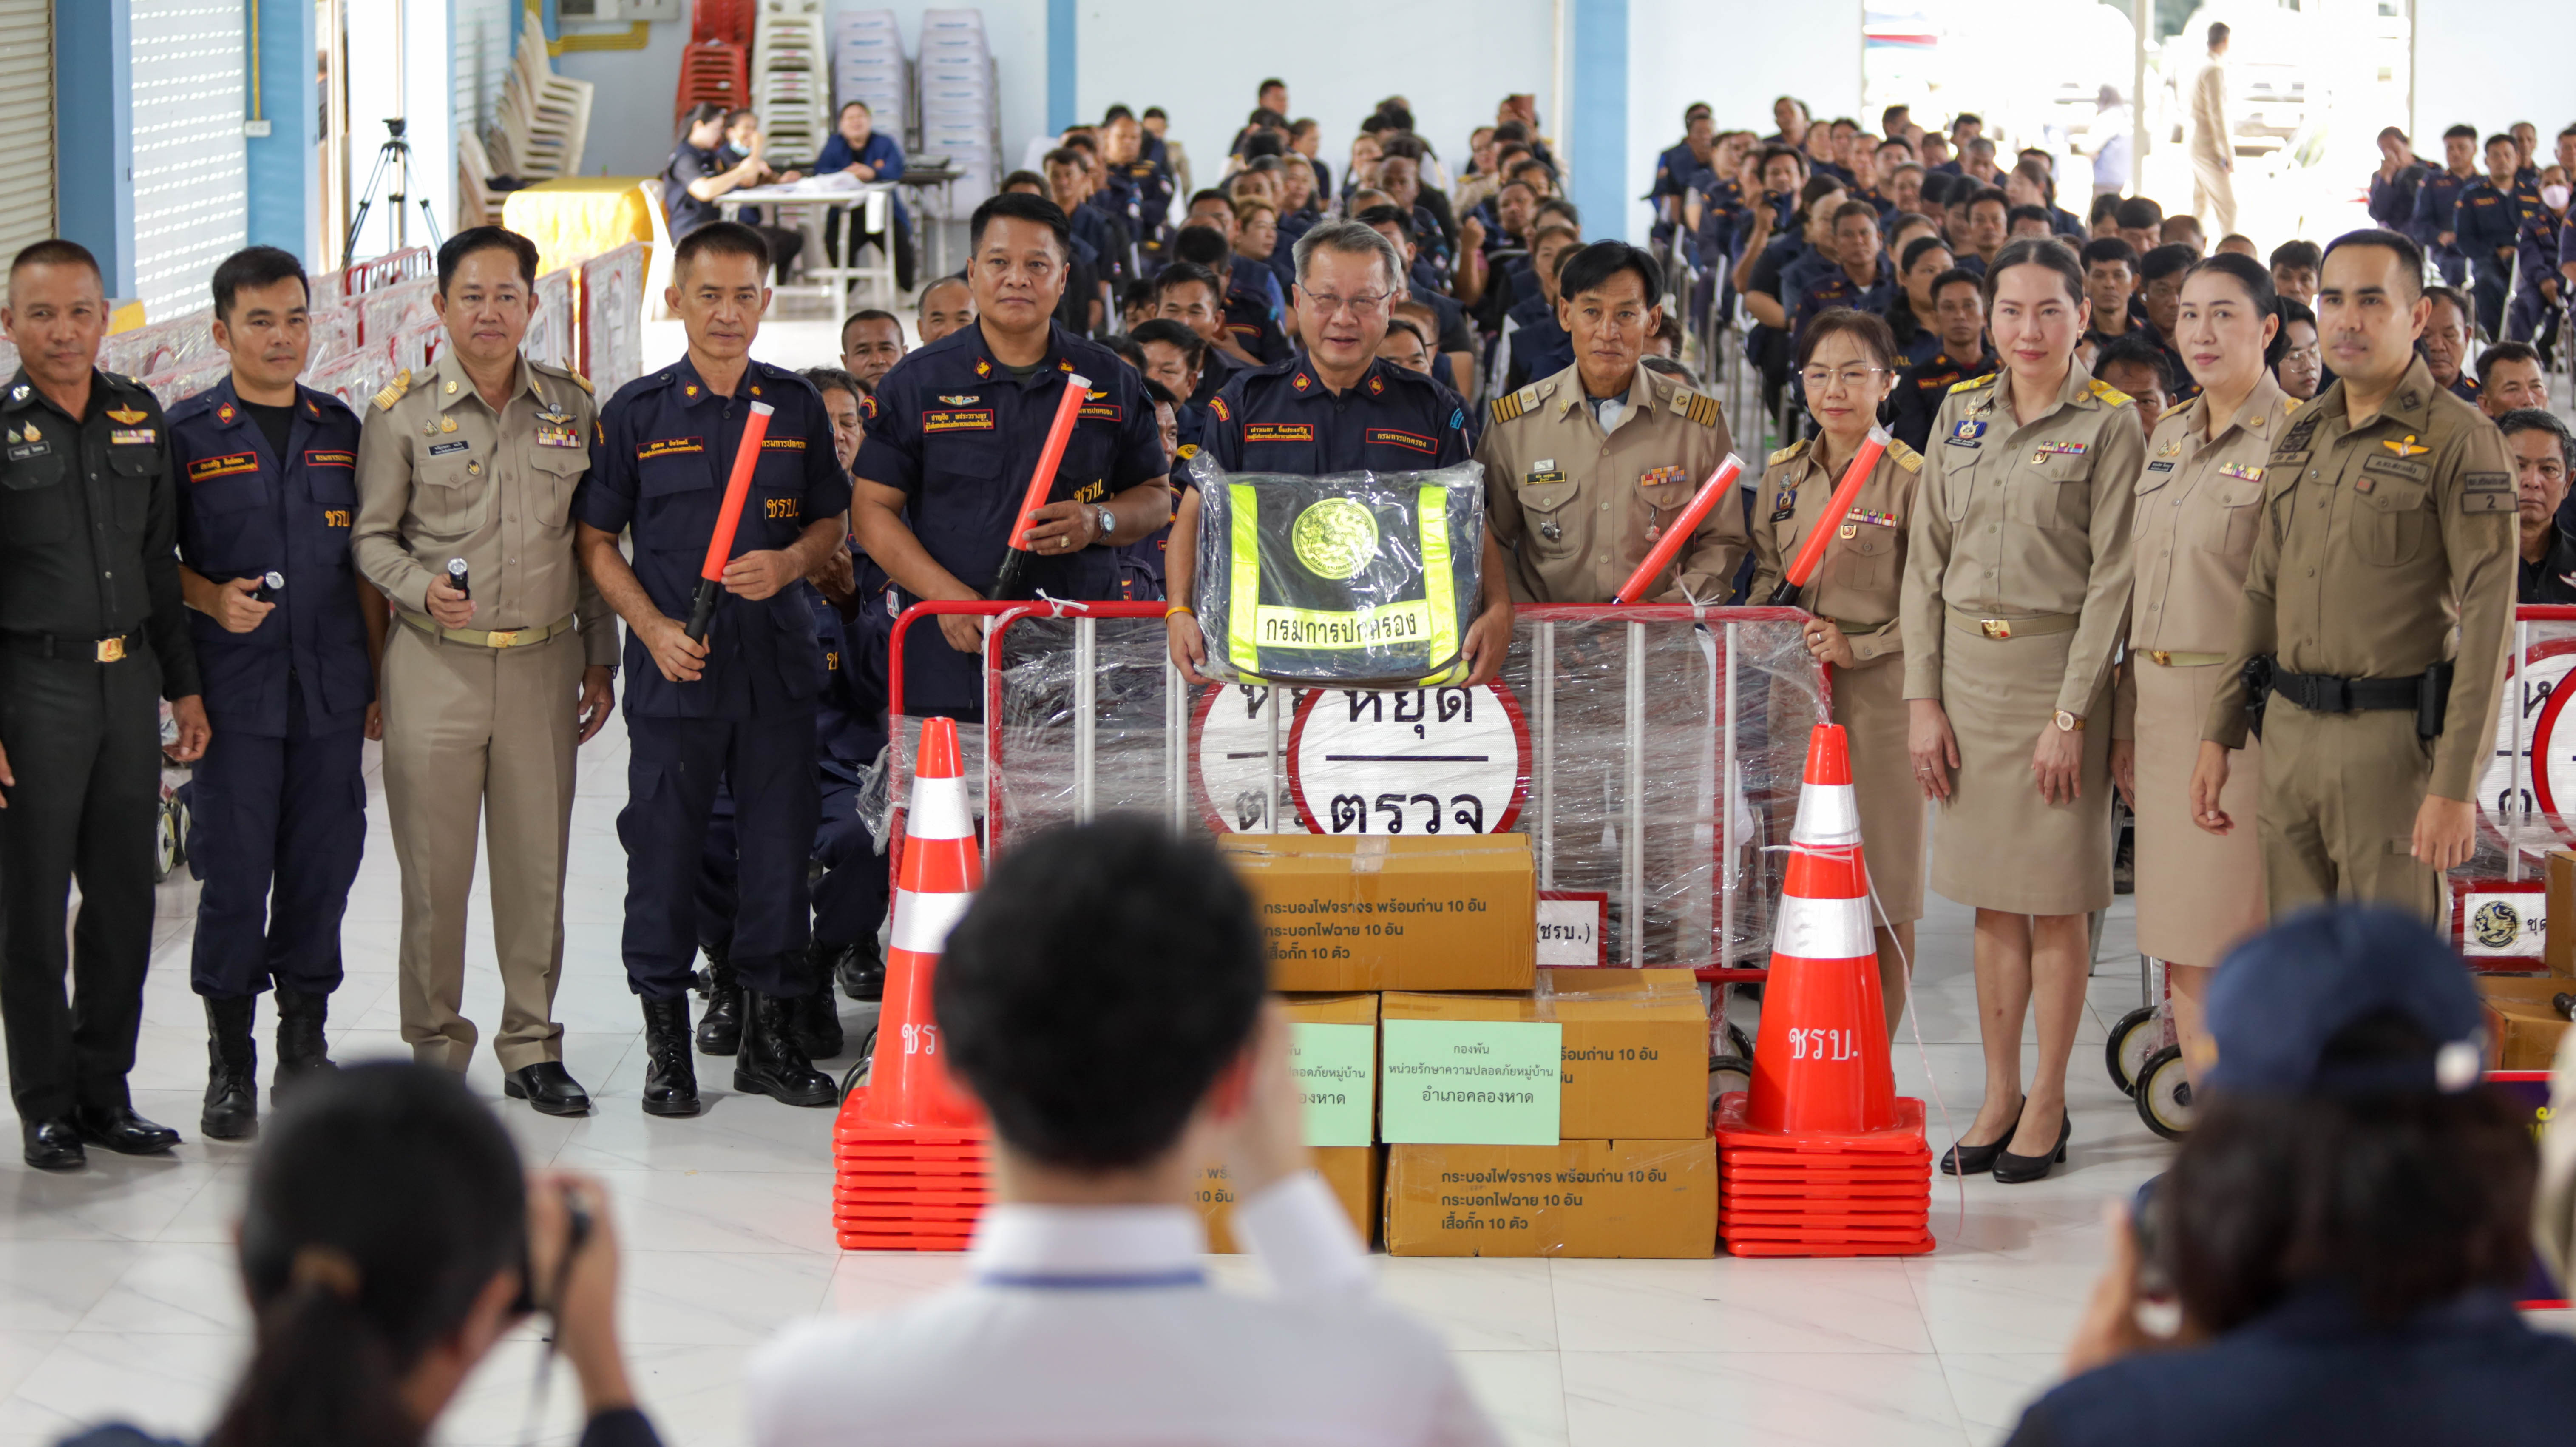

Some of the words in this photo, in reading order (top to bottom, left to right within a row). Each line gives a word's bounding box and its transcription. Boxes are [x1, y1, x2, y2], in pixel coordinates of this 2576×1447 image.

[1377, 433, 1427, 447] กรมการปกครอง
[1074, 479, 1104, 503] ชรบ.
[767, 499, 799, 517] ชรบ.
[2486, 495, 2496, 509] 2
[1267, 613, 1416, 643] กรมการปกครอง
[1342, 688, 1472, 739] หยุด
[1331, 793, 1484, 834] ตรวจ
[1264, 899, 1373, 914] กระบองไฟจราจร
[1378, 898, 1443, 913] พร้อมถ่าน
[1448, 901, 1464, 912] 10
[1468, 898, 1486, 912] อัน
[1264, 922, 1359, 936] กระบอกไฟฉาย
[1365, 924, 1381, 936] 10
[1385, 923, 1403, 936] อัน
[1537, 922, 1590, 943] (ชรบ.)
[1312, 948, 1327, 959] 10
[1332, 946, 1350, 959] ตัว
[902, 1023, 938, 1055] ชร
[1789, 1028, 1858, 1060] ชรบ.
[1454, 1042, 1489, 1054] กองพัน
[1561, 1046, 1614, 1060] ร้อมถ่าน
[1619, 1049, 1635, 1060] 10
[1639, 1046, 1658, 1060] อัน
[1389, 1063, 1553, 1080] หน่วยรักษาความปลอดภัยหมู่บ้าน
[1423, 1085, 1534, 1103] อำเภอคลองหาด
[1442, 1169, 1551, 1183] กระบองไฟจราจร
[1557, 1168, 1623, 1183] พร้อมถ่าน
[1628, 1171, 1644, 1183] 10
[1648, 1168, 1667, 1183] อัน
[1194, 1191, 1211, 1203] 10
[1215, 1189, 1234, 1203] อัน
[1442, 1192, 1538, 1206] กระบอกไฟฉาย
[1543, 1194, 1559, 1206] 10
[1564, 1192, 1583, 1206] อัน
[1442, 1212, 1484, 1229] เสื้อกั๊ก
[1489, 1217, 1505, 1229] 10
[1509, 1216, 1528, 1229] ตัว
